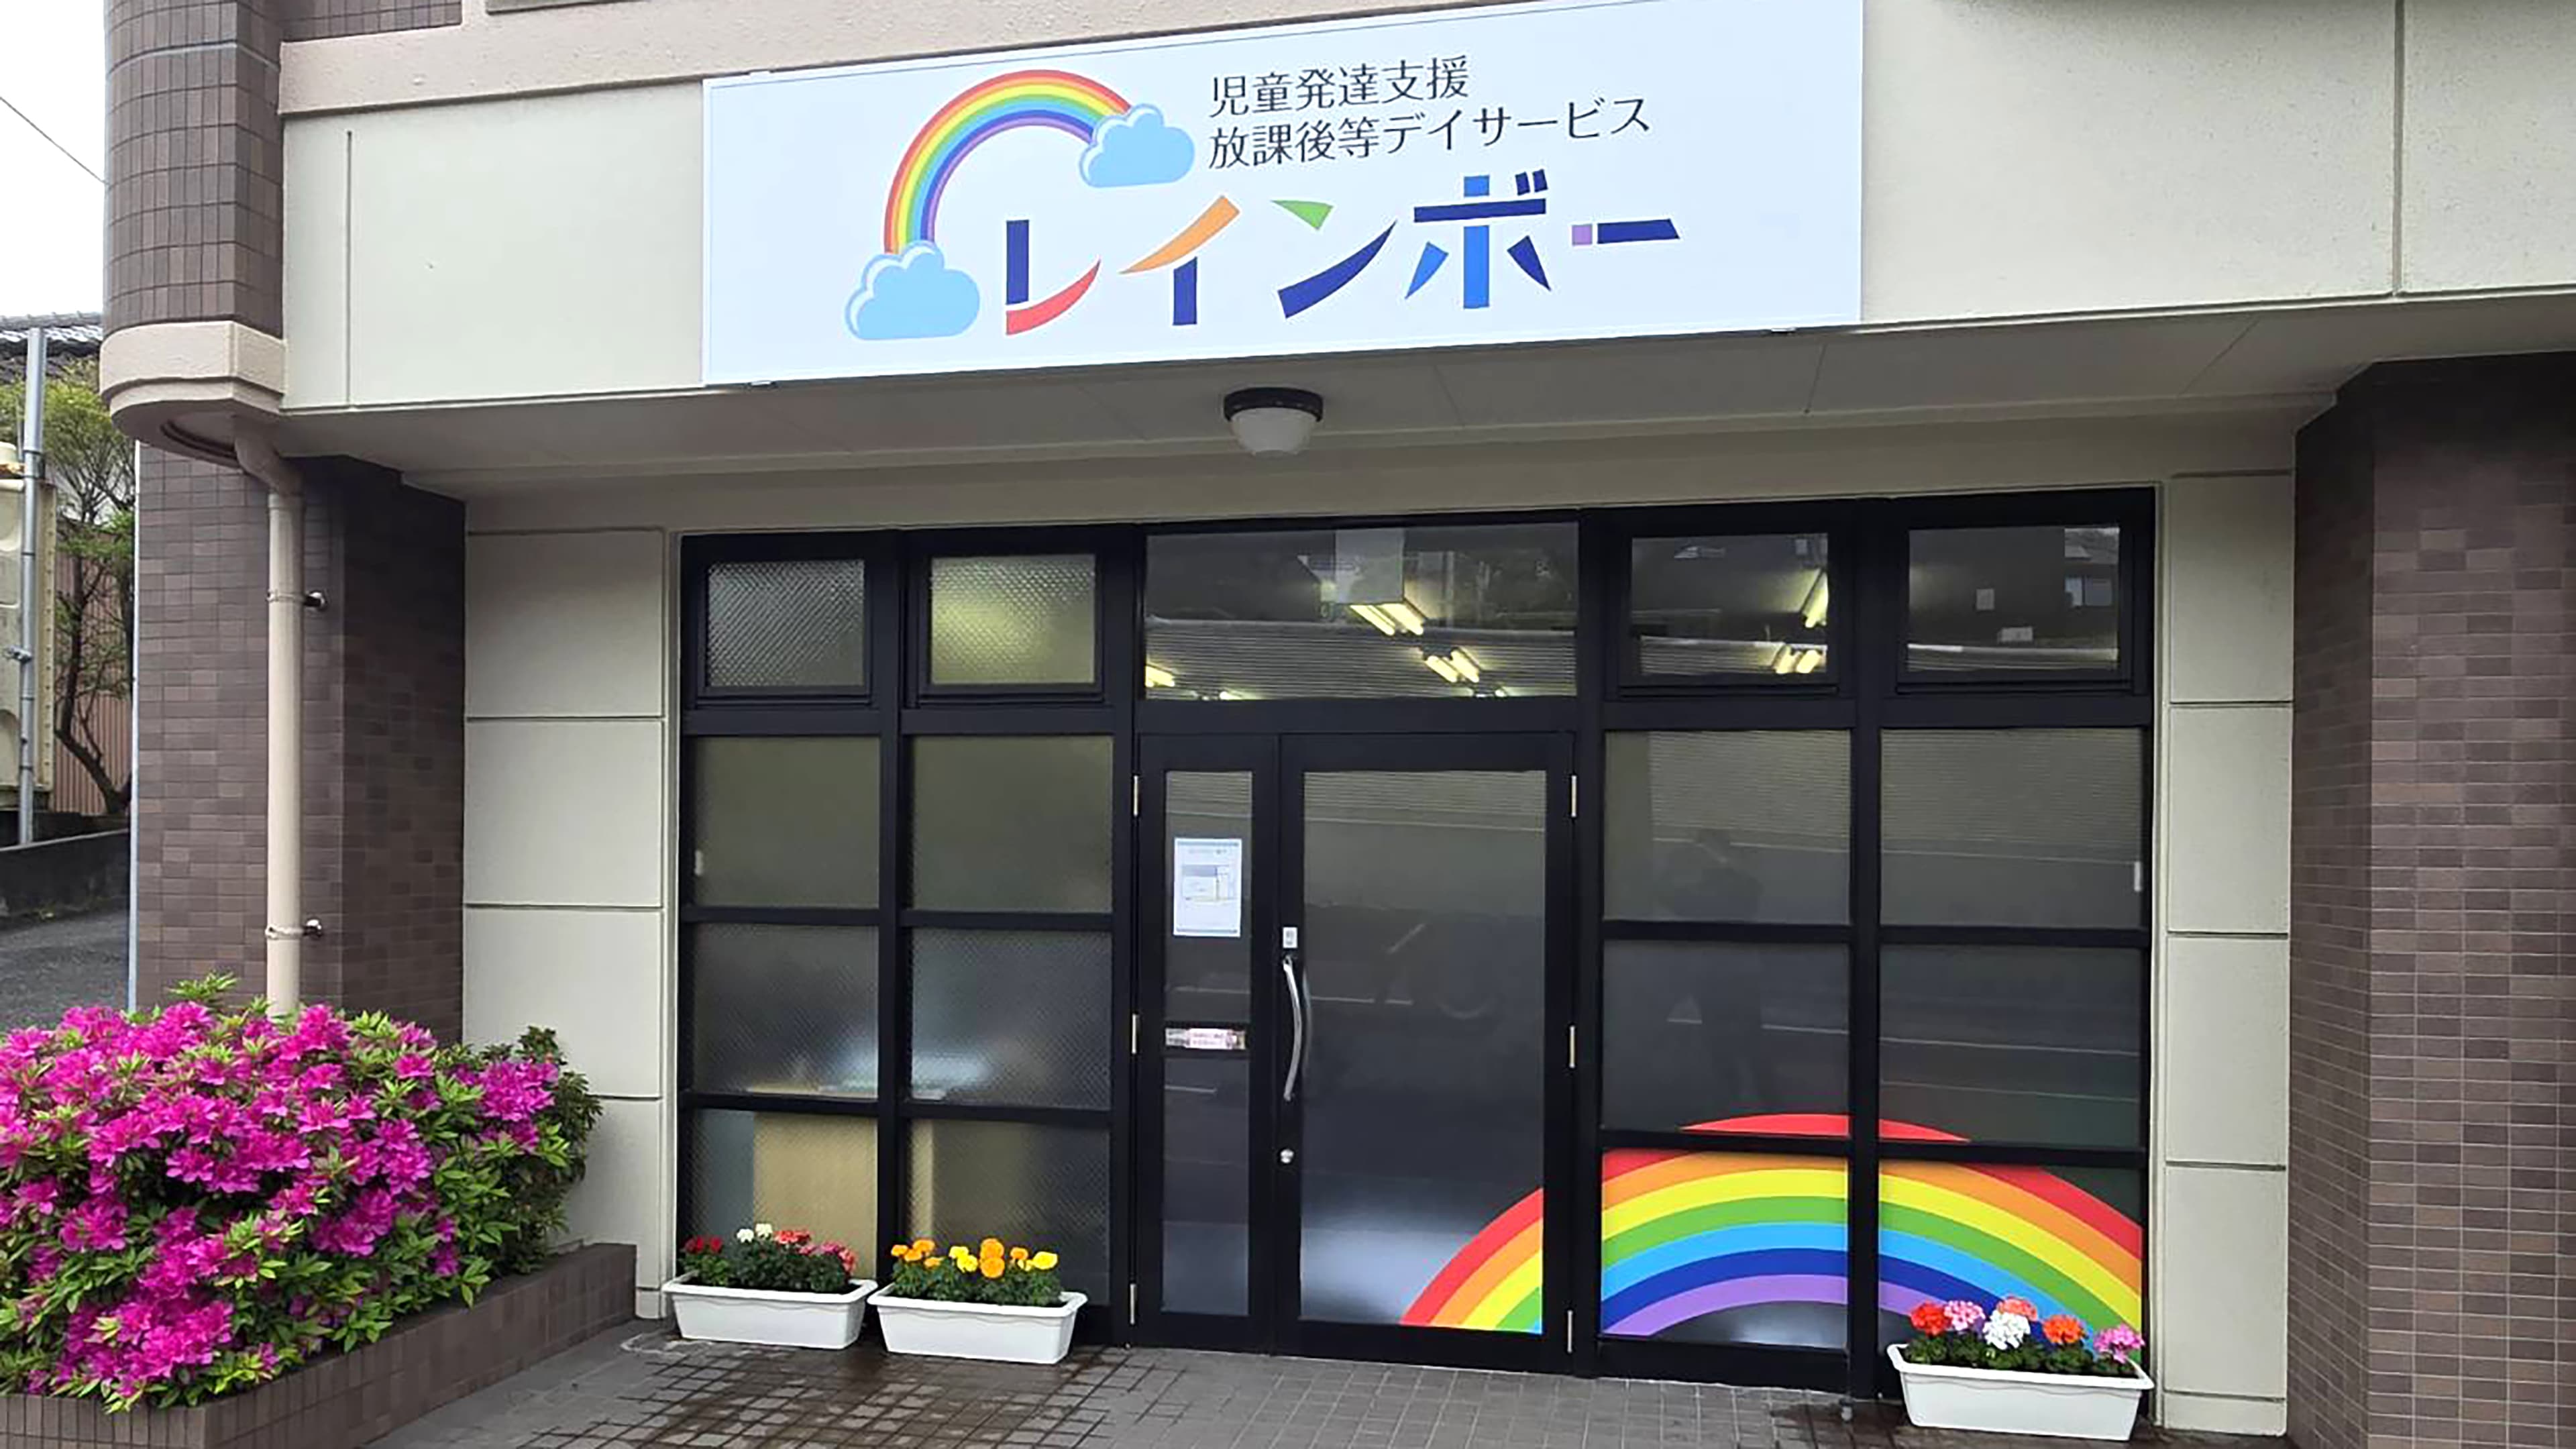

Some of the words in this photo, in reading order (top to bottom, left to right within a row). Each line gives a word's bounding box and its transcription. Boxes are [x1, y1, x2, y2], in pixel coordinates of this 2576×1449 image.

[1210, 54, 1469, 117] 児童発達支援
[1208, 95, 1650, 169] 放課後等デイサービス
[1006, 169, 1680, 335] レインボー
